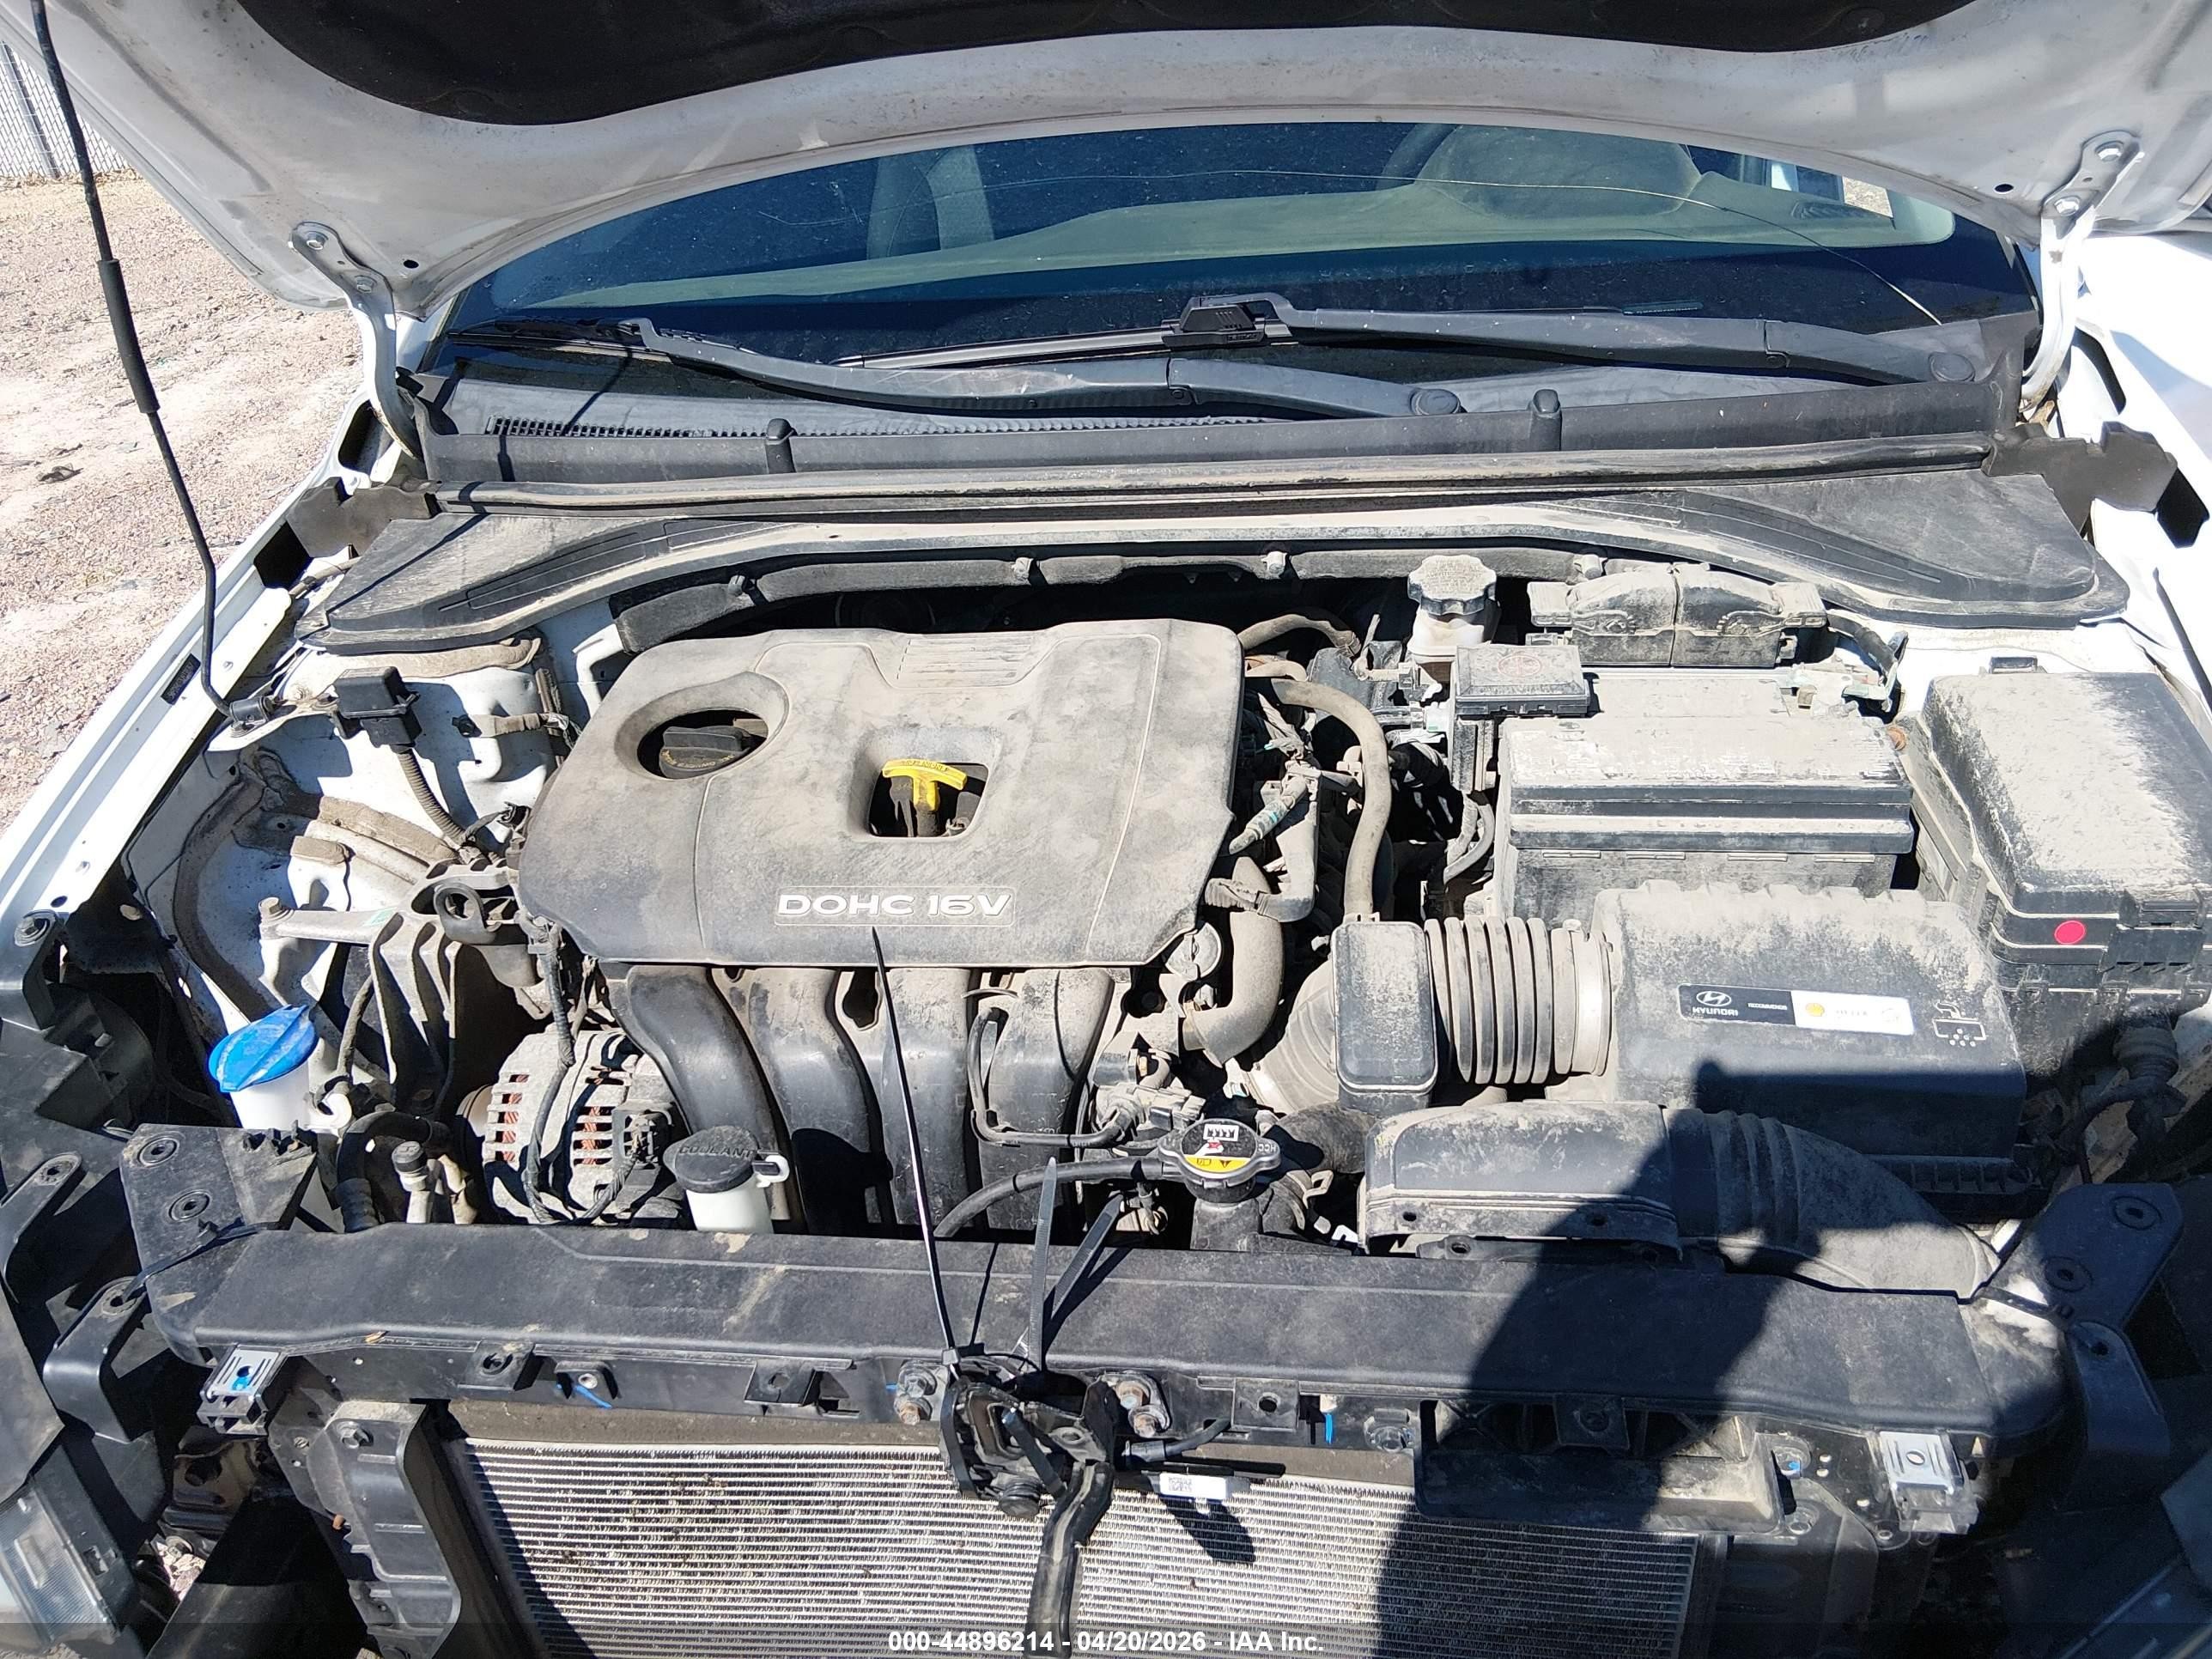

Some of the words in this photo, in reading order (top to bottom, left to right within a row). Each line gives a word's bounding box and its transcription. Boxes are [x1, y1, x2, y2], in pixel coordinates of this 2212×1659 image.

[777, 894, 915, 915] DOHC
[927, 894, 1012, 916] 16V
[1692, 1006, 1739, 1017] HYUNDAI
[679, 1146, 754, 1160] COOLANT
[1258, 1143, 1277, 1152] HCC
